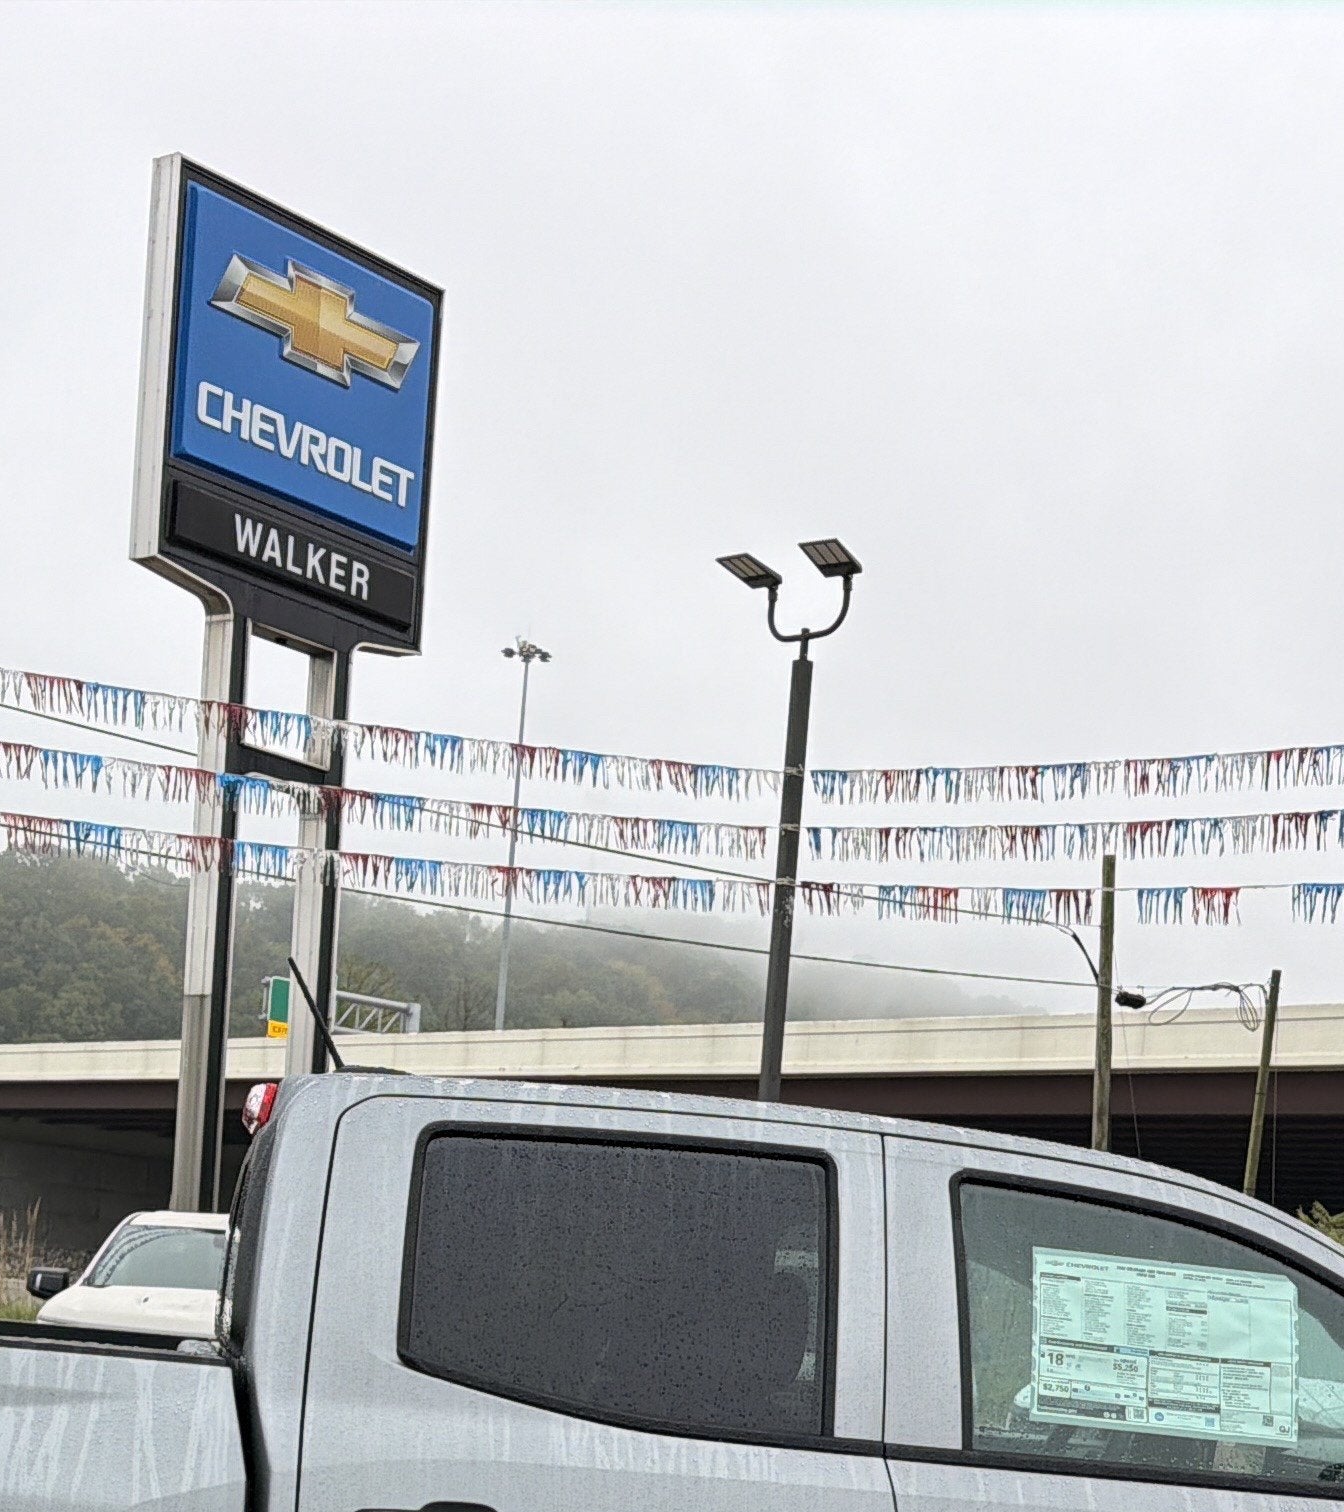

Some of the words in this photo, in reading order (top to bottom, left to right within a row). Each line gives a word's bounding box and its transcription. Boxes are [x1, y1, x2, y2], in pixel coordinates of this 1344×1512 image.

[197, 381, 415, 508] CHEVROLET
[234, 513, 370, 601] WALKER
[1047, 1352, 1064, 1366] 18
